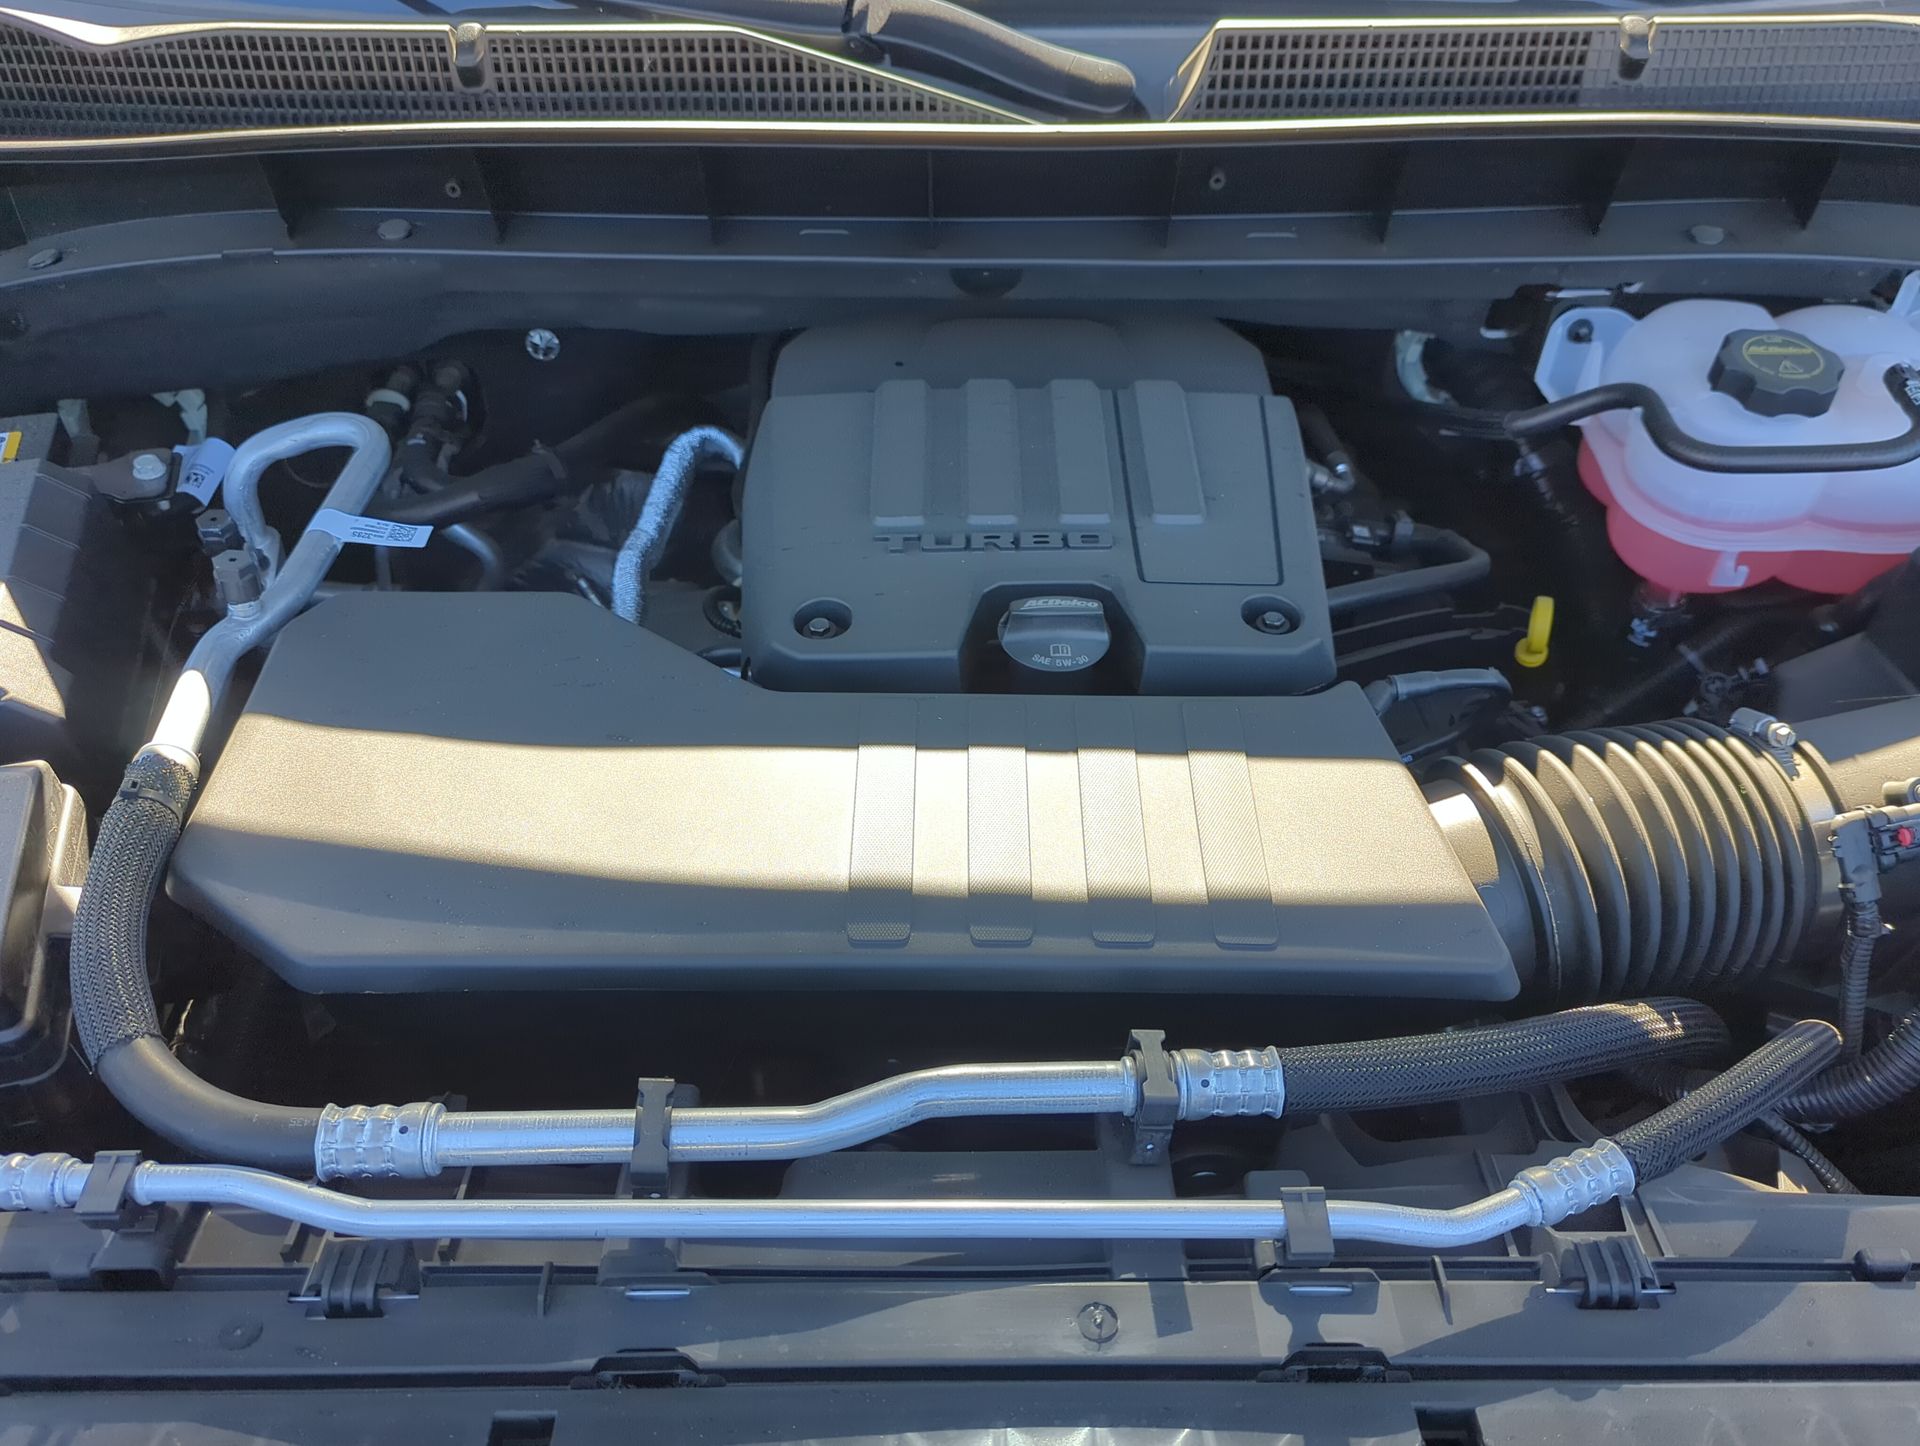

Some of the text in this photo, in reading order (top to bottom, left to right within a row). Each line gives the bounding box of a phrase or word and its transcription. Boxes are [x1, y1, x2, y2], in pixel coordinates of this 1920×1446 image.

[873, 532, 1113, 553] TURBO
[1020, 598, 1099, 610] ACDelco
[1032, 653, 1089, 667] SAE 5W-30
